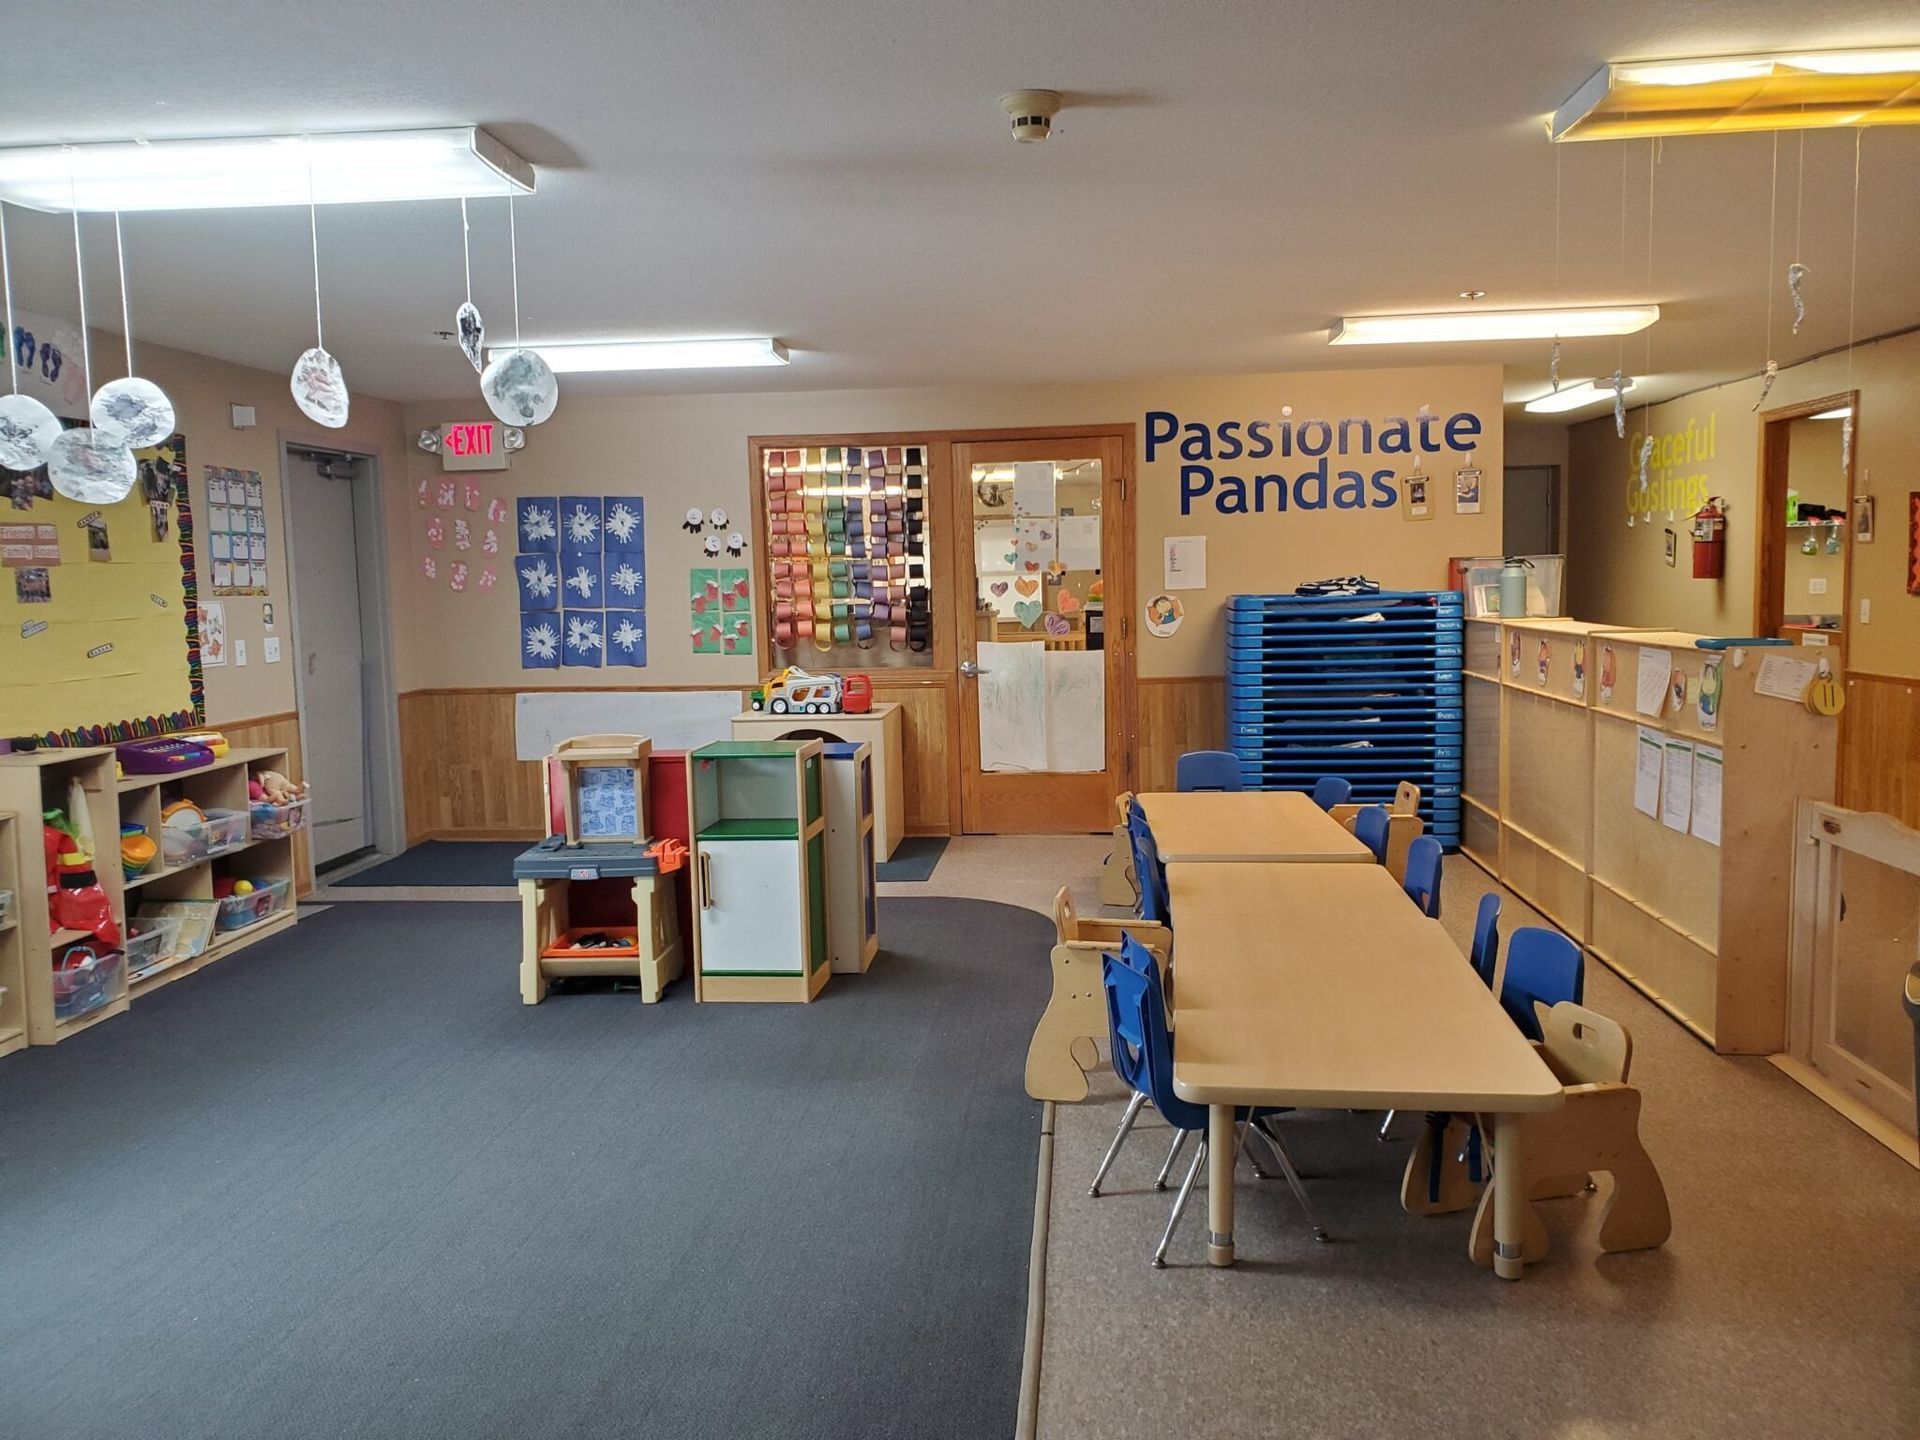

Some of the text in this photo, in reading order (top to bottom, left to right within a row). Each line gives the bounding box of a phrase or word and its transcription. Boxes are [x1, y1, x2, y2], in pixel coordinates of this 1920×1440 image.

[451, 424, 493, 456] EXIT
[1145, 408, 1482, 462] Passionate
[1630, 412, 1716, 471] Gaceful
[1180, 458, 1398, 515] Pandas
[1822, 684, 1835, 709] 11
